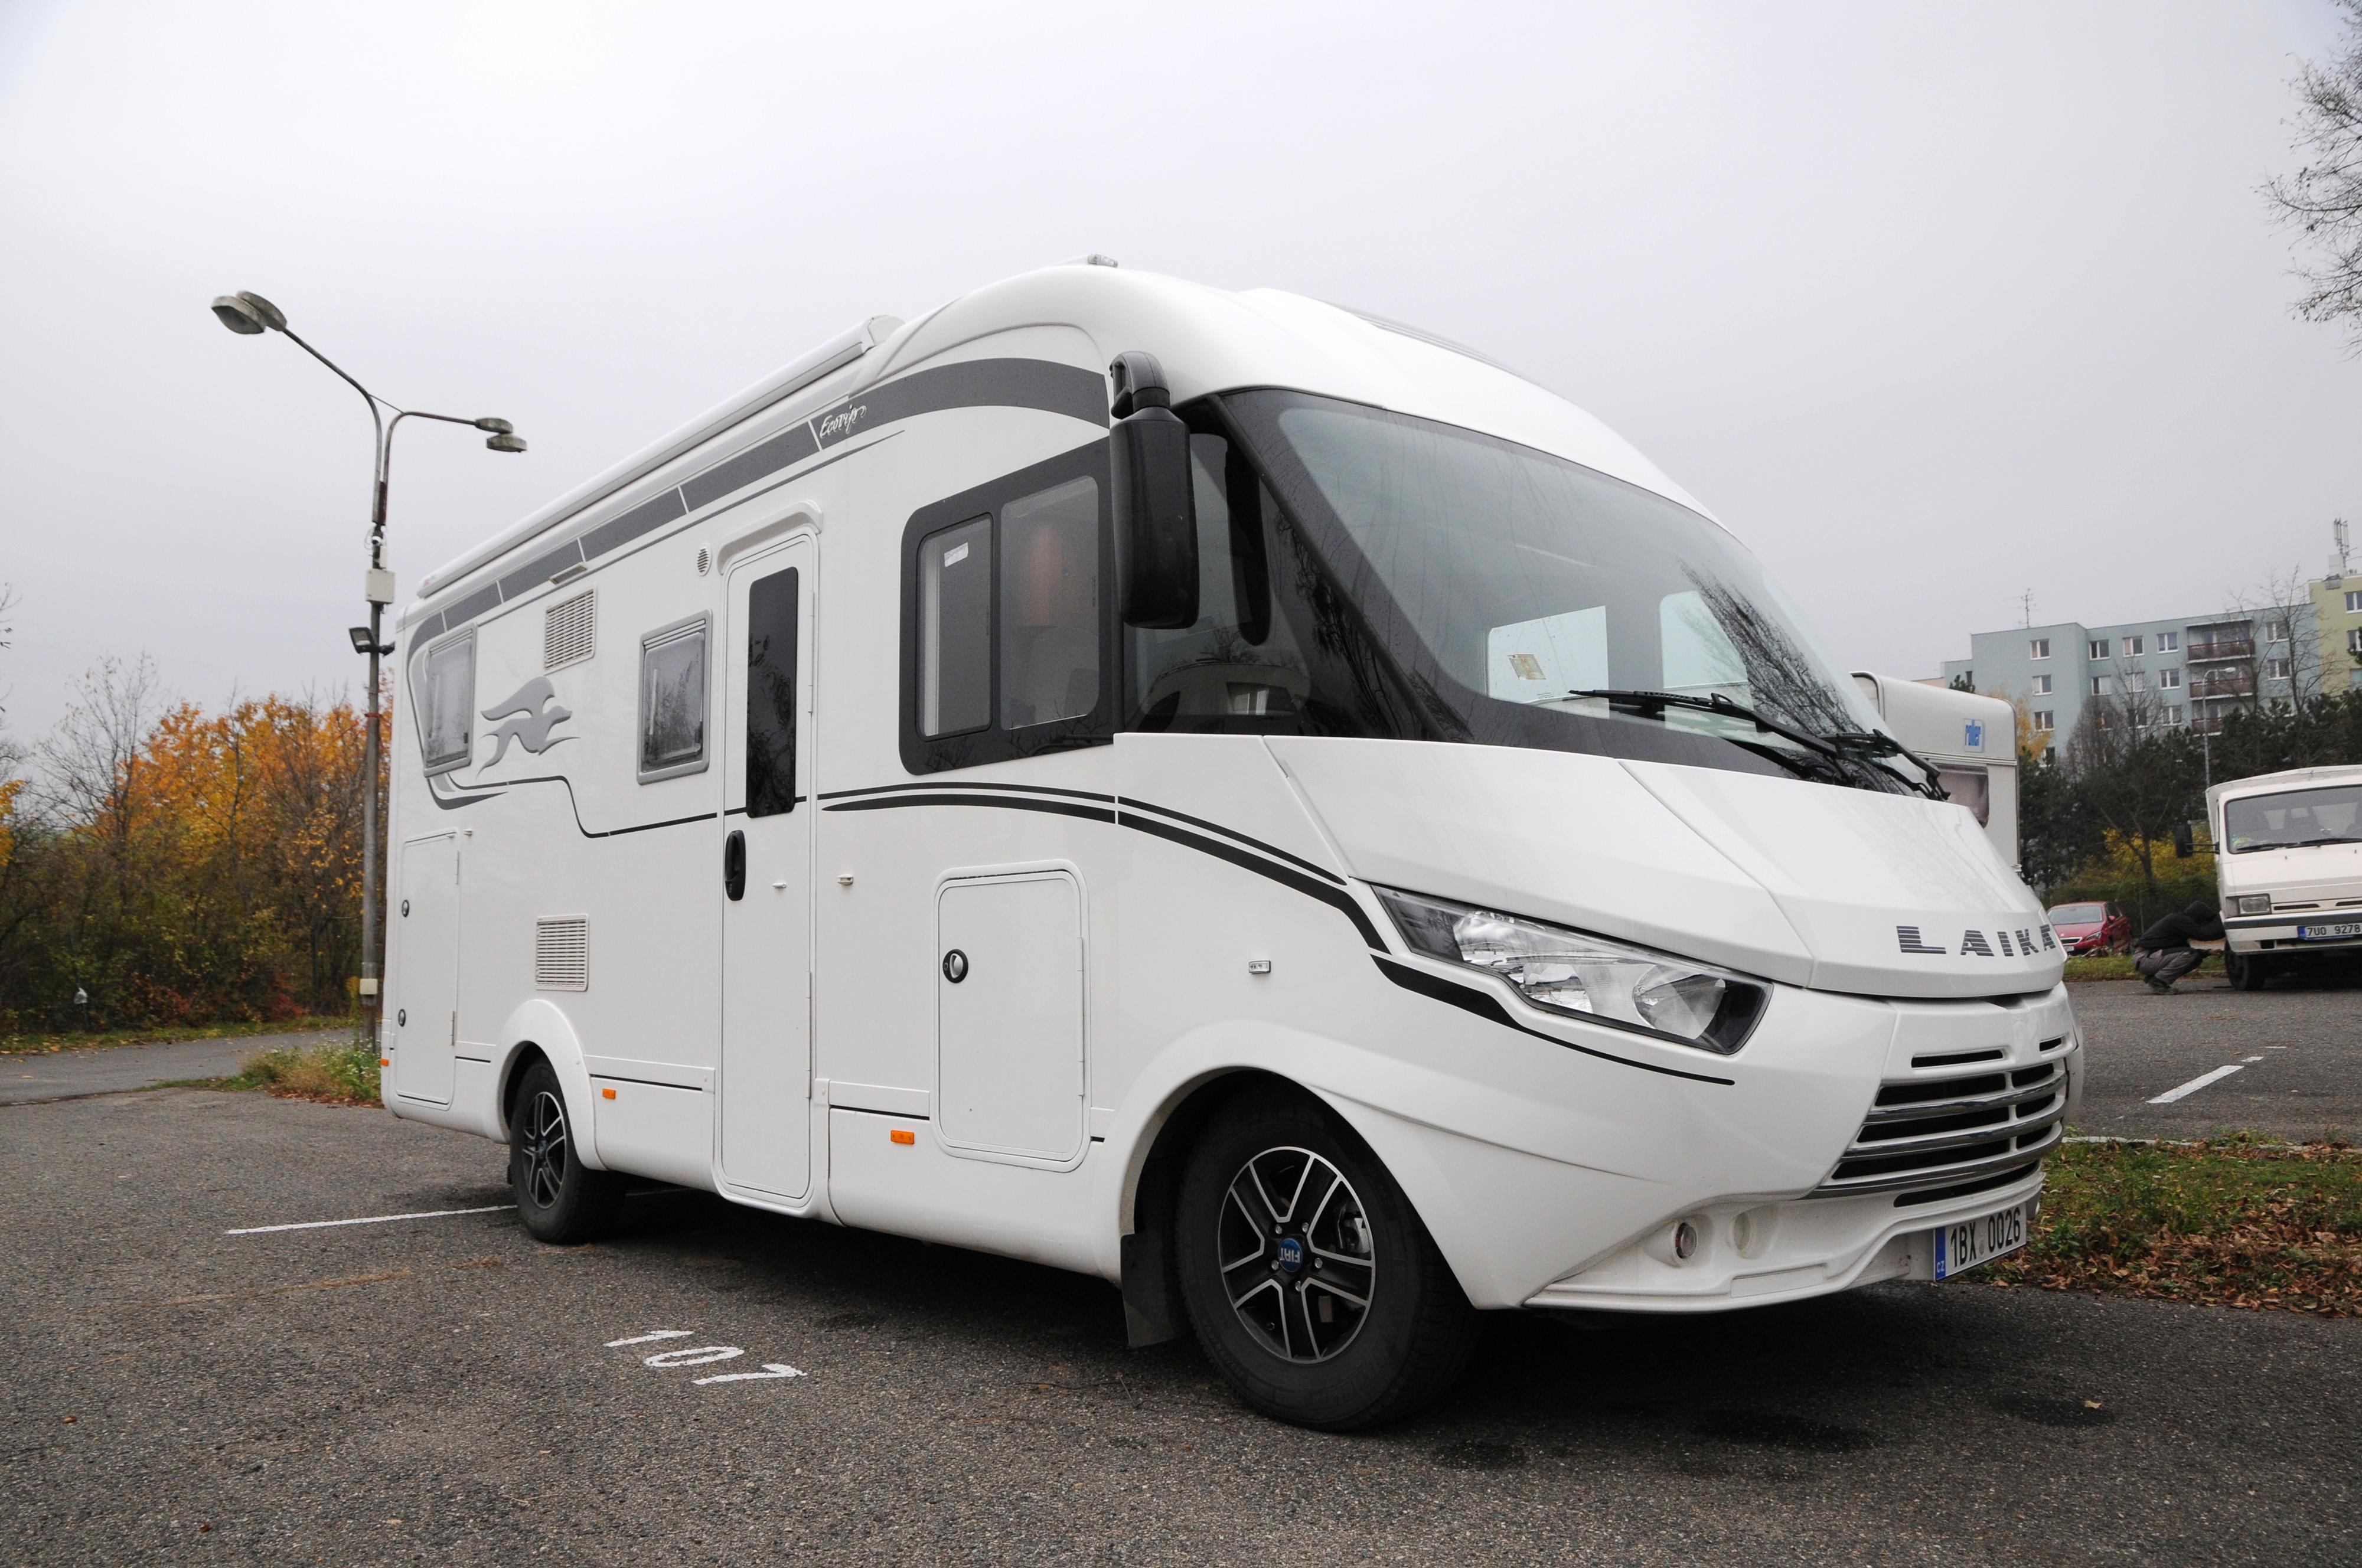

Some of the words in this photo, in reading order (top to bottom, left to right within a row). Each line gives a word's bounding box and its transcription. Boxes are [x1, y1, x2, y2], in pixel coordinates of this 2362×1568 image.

[2334, 924, 2361, 935] 9278
[1896, 924, 2057, 957] LAIKA
[1950, 1221, 1976, 1268] 1BX
[1988, 1207, 2021, 1253] 0026
[1279, 1247, 1300, 1263] FIAT
[1936, 1260, 1945, 1273] CZ
